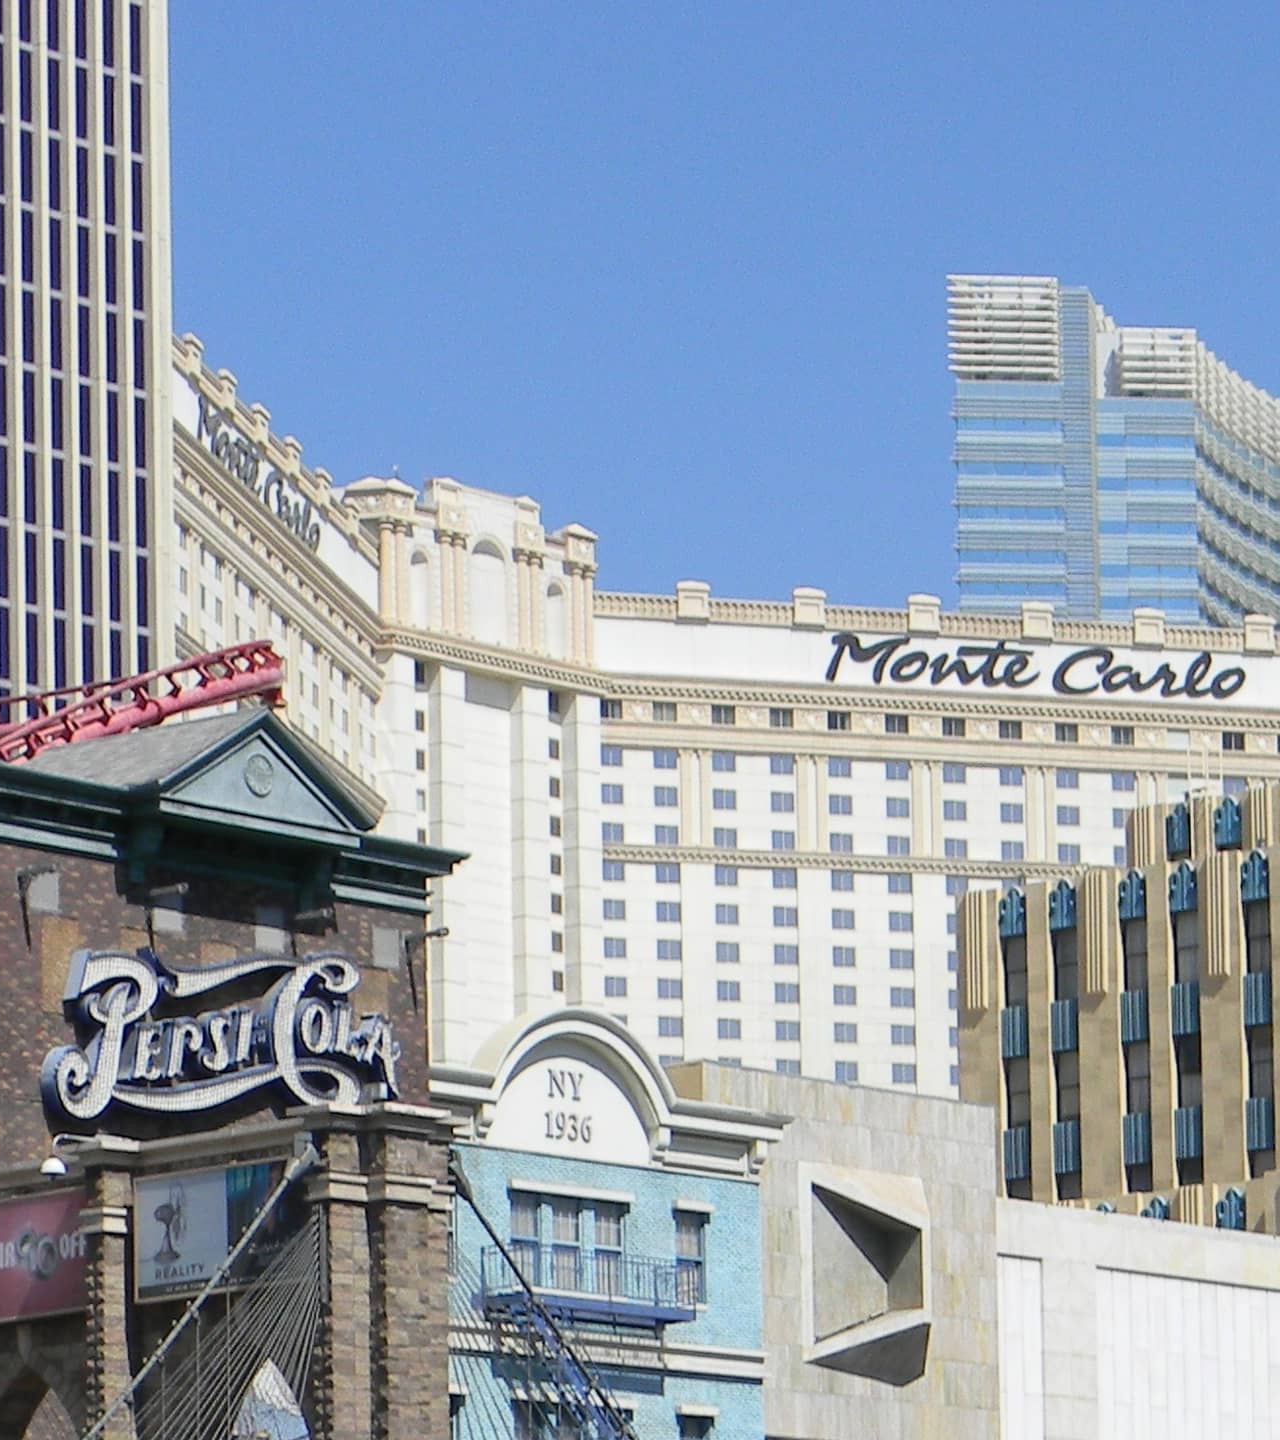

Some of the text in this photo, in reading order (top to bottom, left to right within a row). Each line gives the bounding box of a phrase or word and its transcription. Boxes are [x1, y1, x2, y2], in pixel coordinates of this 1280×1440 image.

[825, 632, 1246, 700] Monte Carlo
[547, 1068, 584, 1102] NY
[544, 1110, 592, 1144] 1936
[154, 1263, 206, 1281] REALITY
